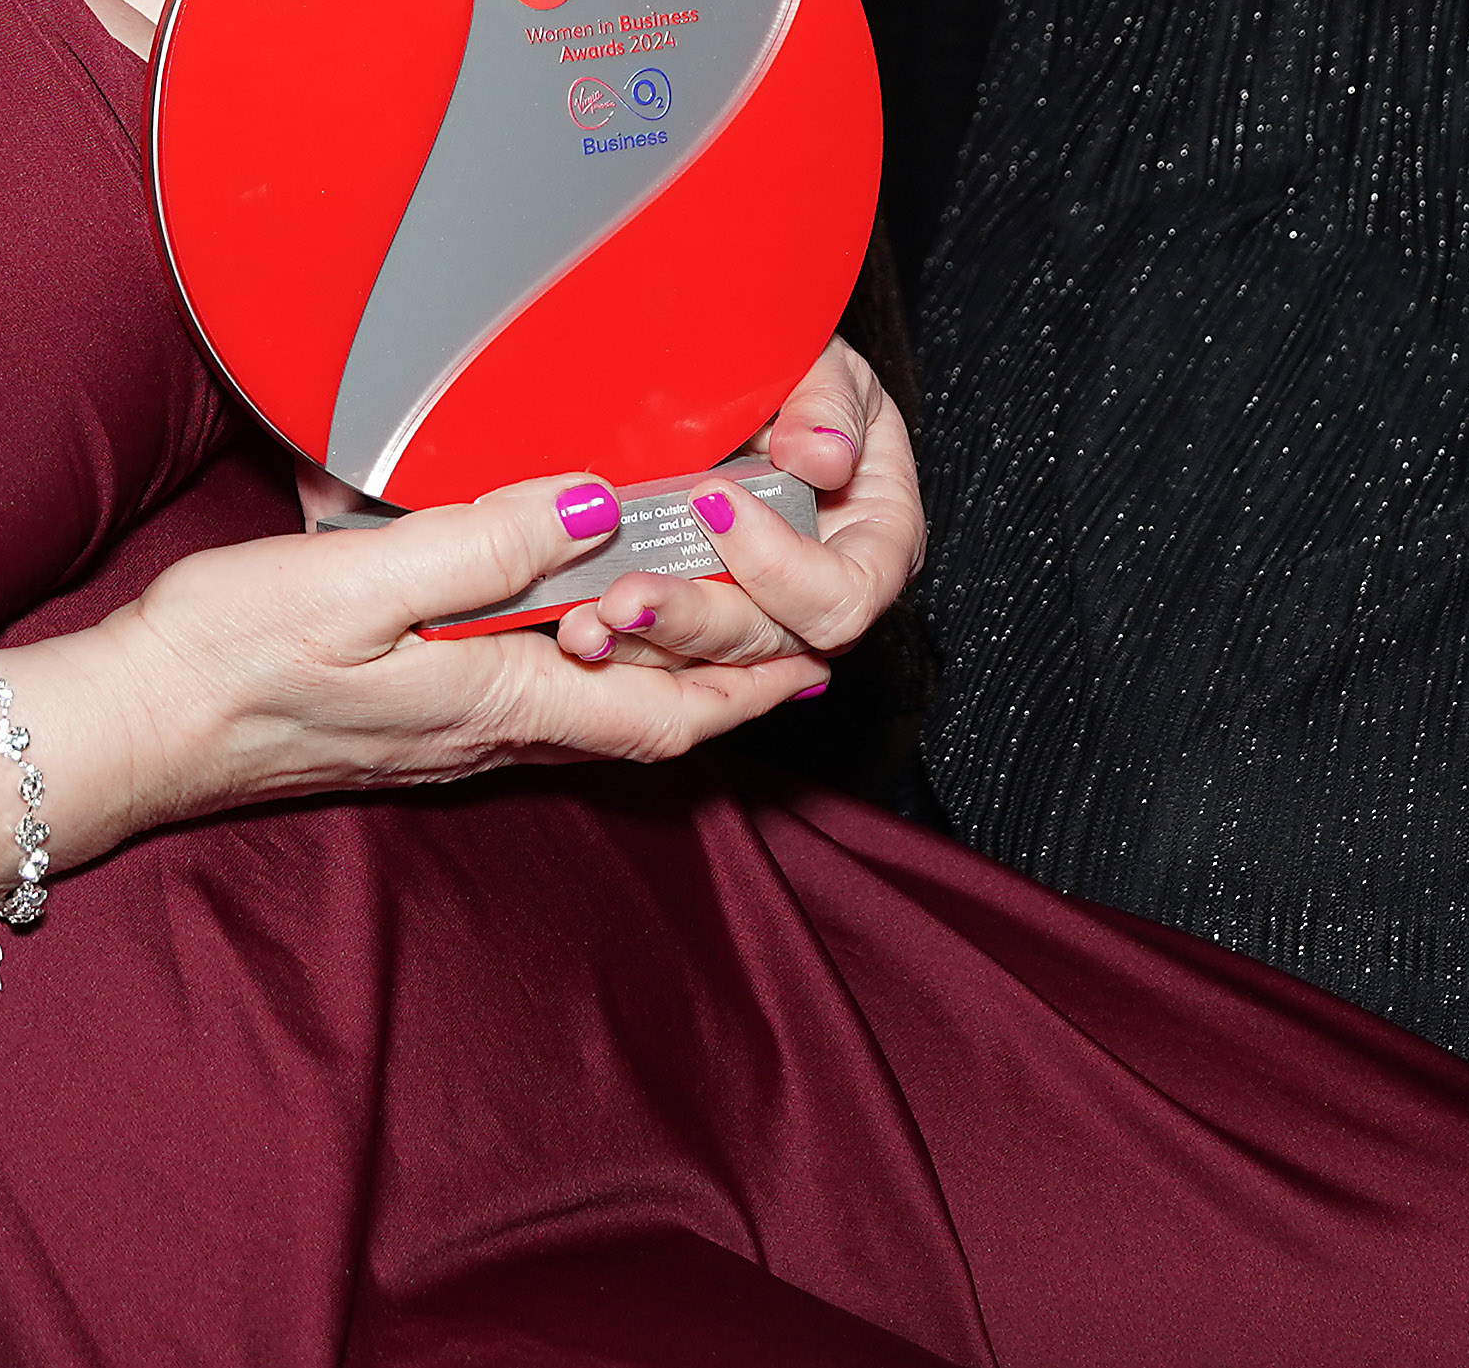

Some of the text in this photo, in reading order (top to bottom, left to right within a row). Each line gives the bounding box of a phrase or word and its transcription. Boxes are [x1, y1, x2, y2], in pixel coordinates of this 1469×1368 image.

[525, 9, 699, 44] Women in Business
[559, 31, 677, 63] Awards 2024
[582, 130, 668, 155] Business
[620, 510, 639, 525] ard
[639, 507, 653, 521] for
[658, 517, 680, 532] and
[631, 533, 682, 553] sponsored
[683, 530, 698, 543] by
[669, 556, 712, 573] McAdoo
